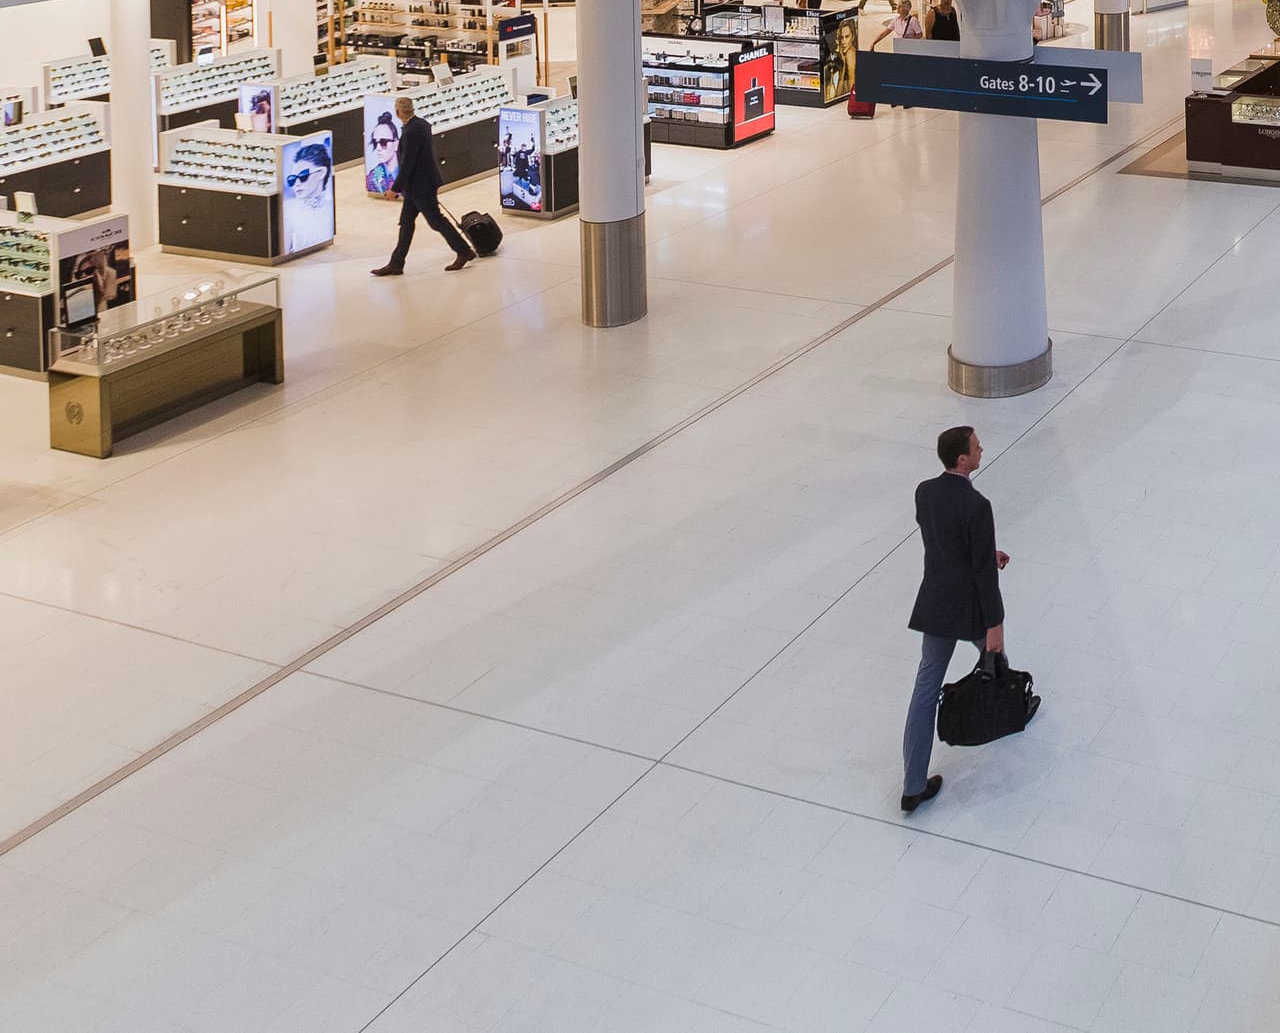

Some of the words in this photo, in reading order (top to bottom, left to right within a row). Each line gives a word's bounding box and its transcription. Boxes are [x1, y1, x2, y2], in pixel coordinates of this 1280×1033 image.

[739, 47, 769, 63] CHANEL
[980, 75, 1015, 91] Gates
[1019, 74, 1056, 94] 8-10
